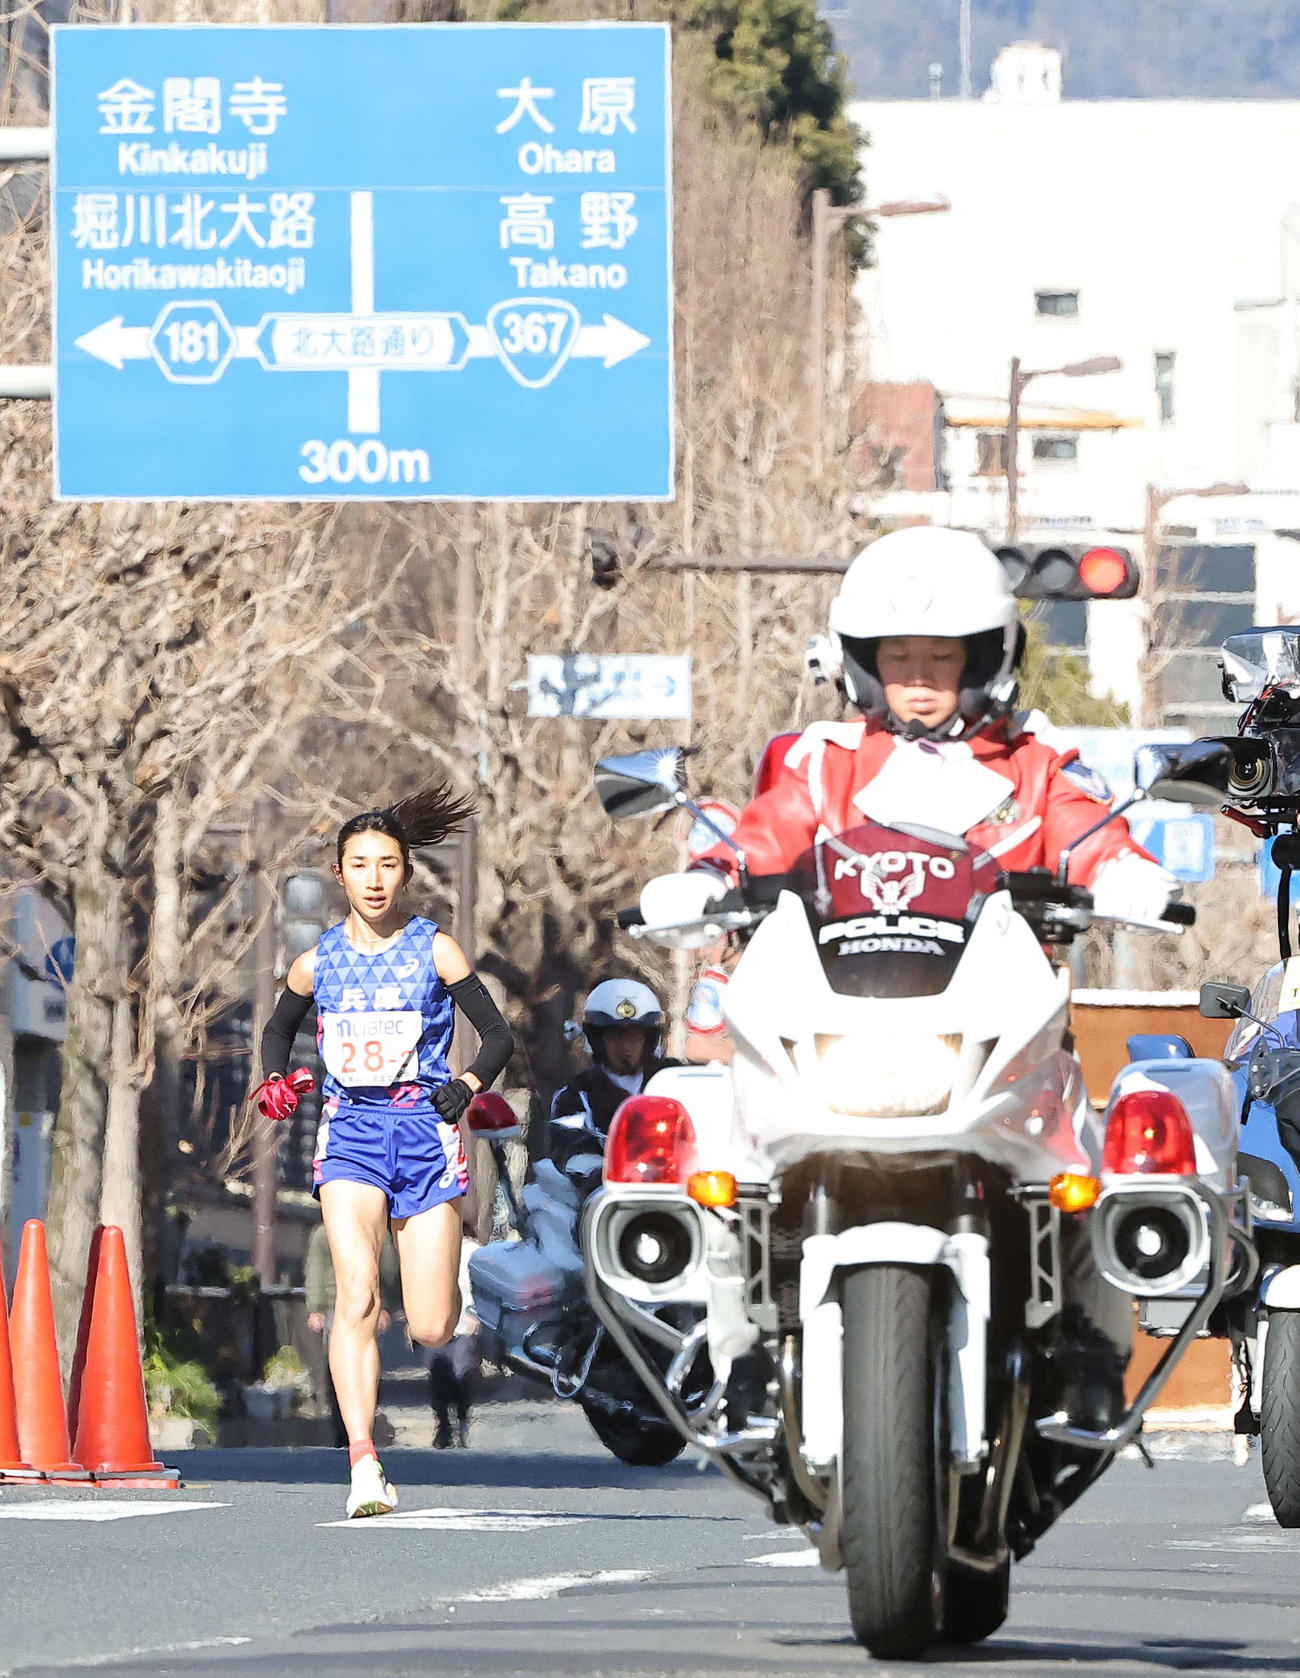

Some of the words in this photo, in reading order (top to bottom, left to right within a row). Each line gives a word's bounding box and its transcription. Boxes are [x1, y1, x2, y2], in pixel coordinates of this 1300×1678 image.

[98, 76, 287, 135] 金閣寺
[496, 76, 637, 135] 大原
[118, 142, 268, 179] Kinkakuji
[518, 142, 615, 174] Ohara
[71, 192, 316, 249] 堀川北大路
[499, 192, 638, 249] 高野
[82, 258, 306, 294] Horikawakitaoji
[509, 257, 627, 289] Takano
[164, 321, 219, 362] 181
[291, 325, 434, 358] 北大路通り
[502, 313, 566, 354] 367
[298, 440, 431, 484] 300m
[834, 850, 956, 881] KYOTO
[818, 915, 965, 945] POLICE
[838, 937, 946, 956] HONDA
